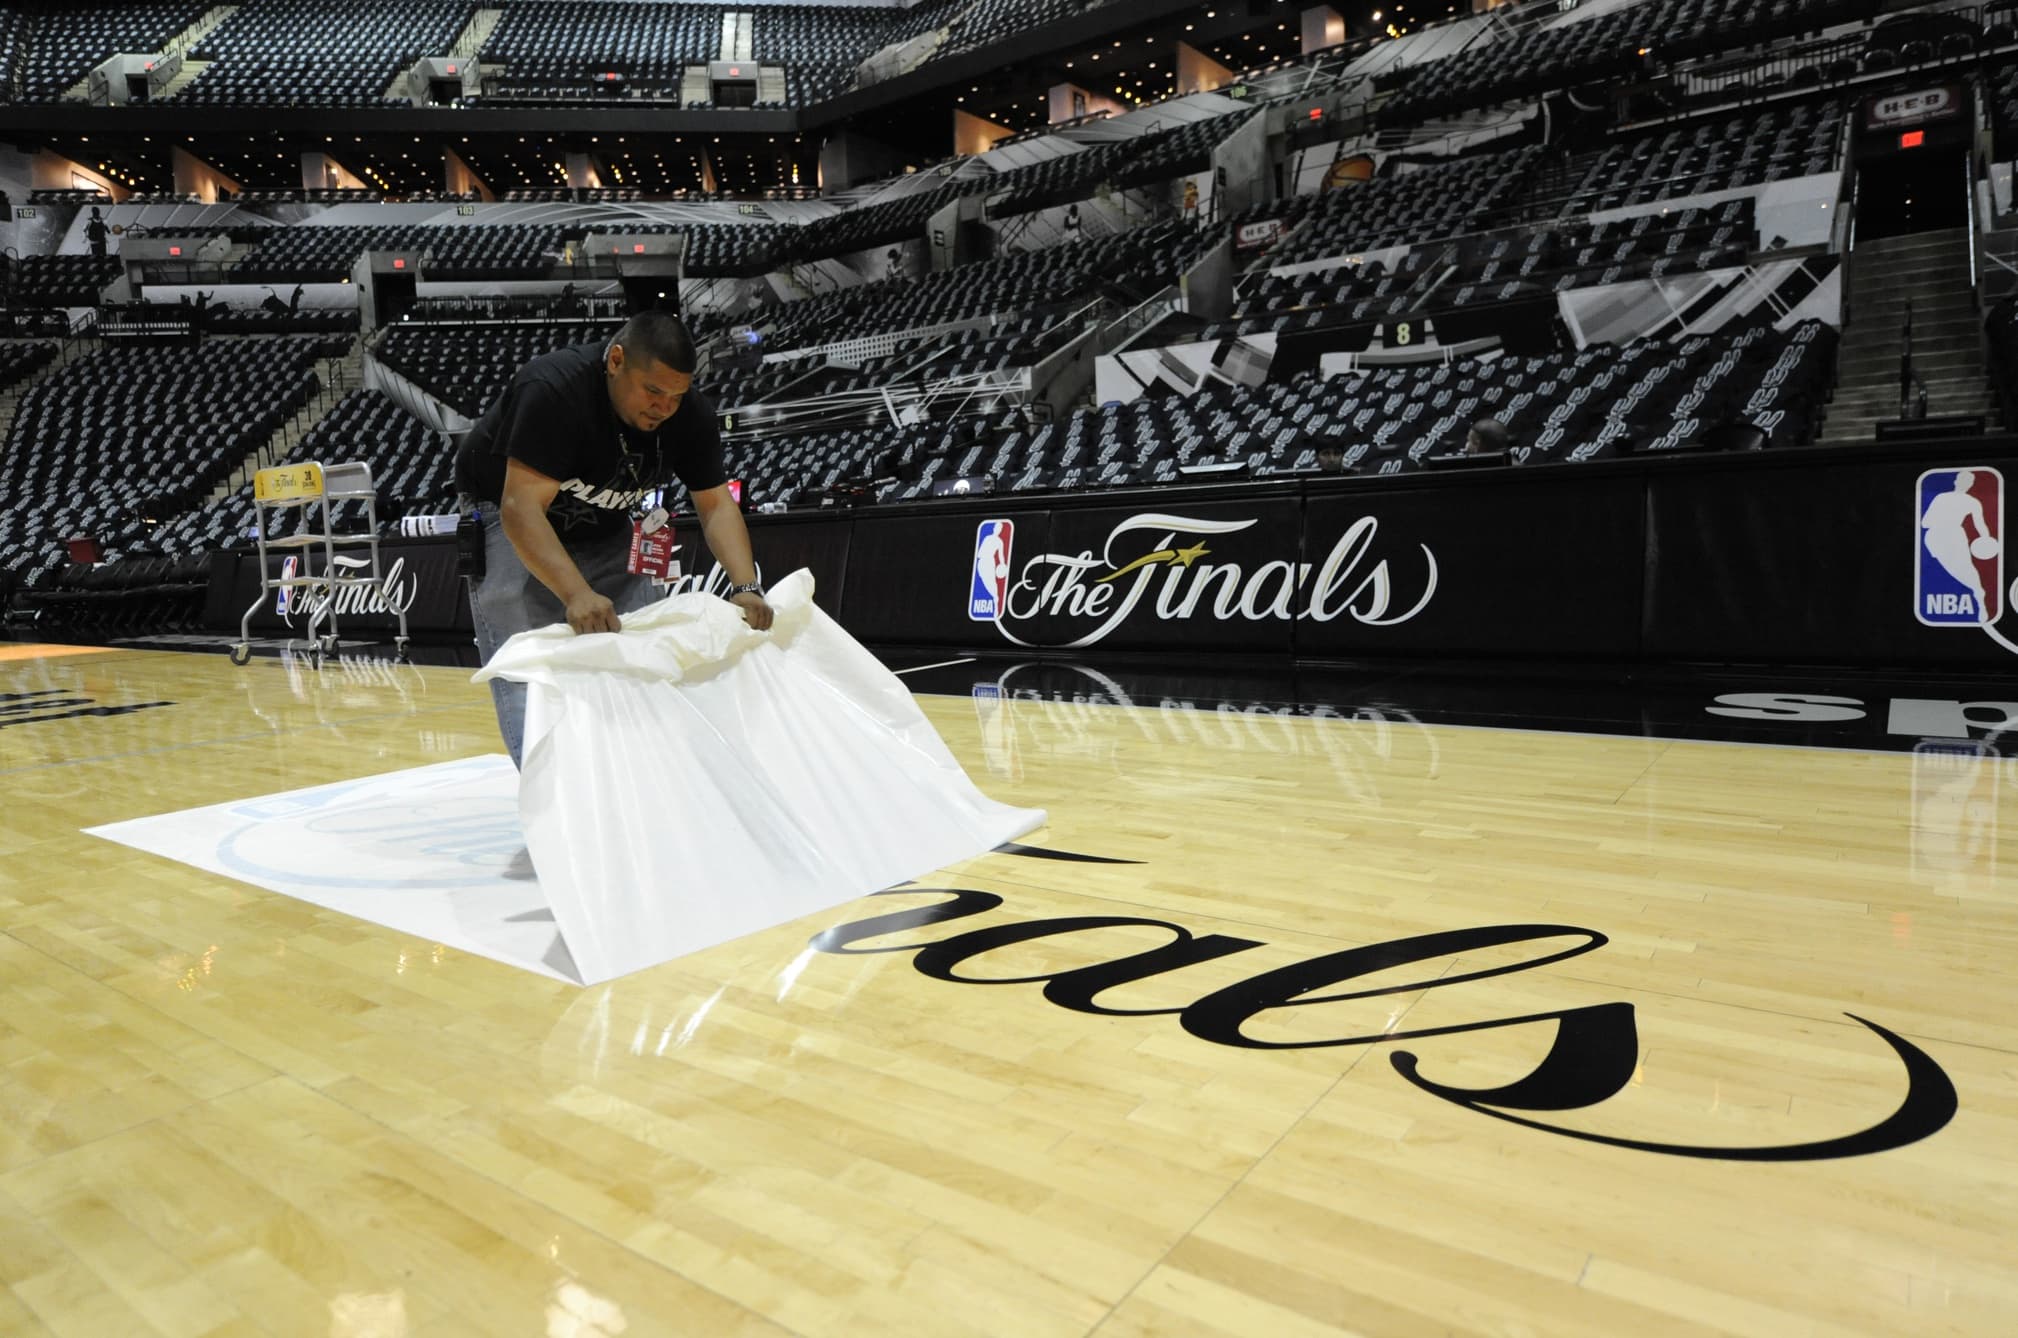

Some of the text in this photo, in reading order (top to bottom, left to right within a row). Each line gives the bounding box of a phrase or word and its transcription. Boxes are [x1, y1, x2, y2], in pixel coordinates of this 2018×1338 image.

[1397, 323, 1410, 345] 8
[725, 415, 733, 430] 6
[1008, 513, 1438, 647] The Finals
[973, 599, 994, 614] NBA
[1926, 594, 1975, 614] NBA
